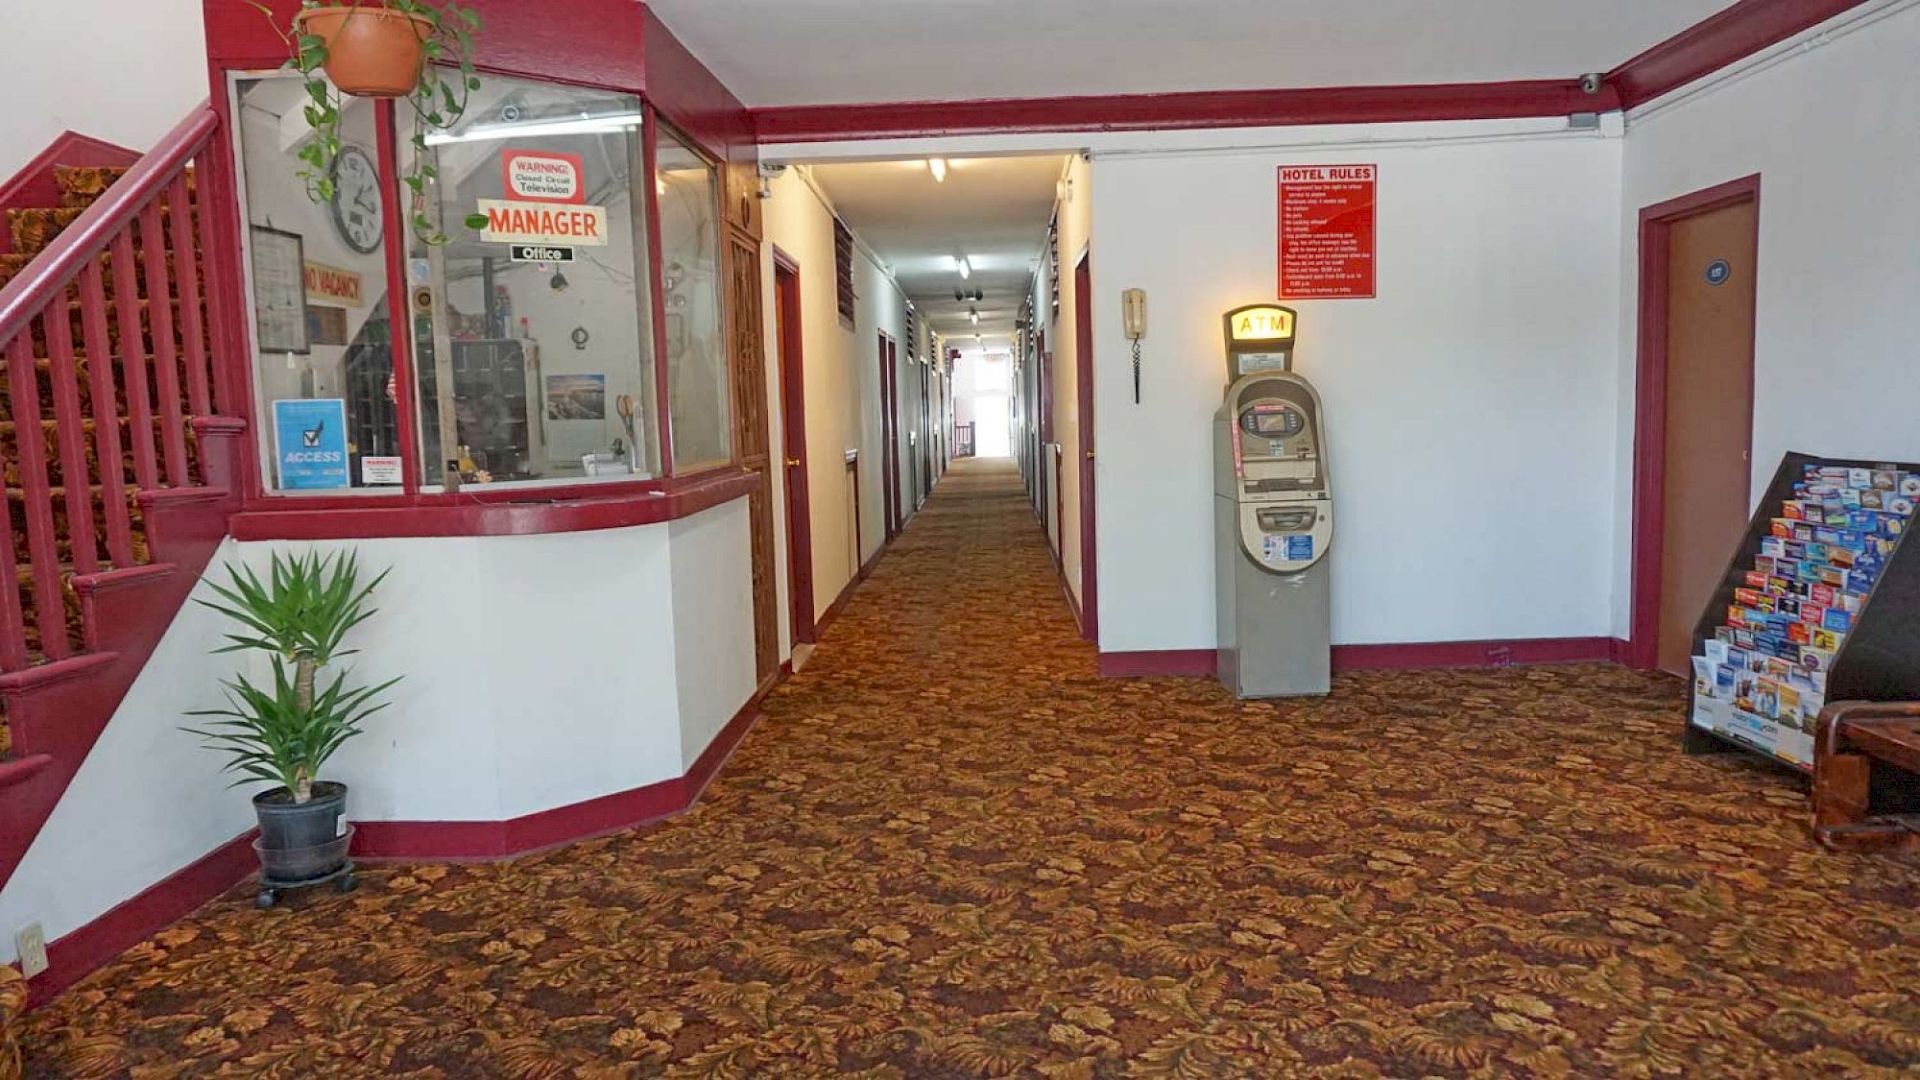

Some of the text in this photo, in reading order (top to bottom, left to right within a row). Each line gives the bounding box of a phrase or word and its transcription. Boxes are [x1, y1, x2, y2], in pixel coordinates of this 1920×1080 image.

[515, 173, 542, 183] Closed
[1282, 168, 1371, 180] HOTEL RULES
[520, 182, 569, 193] Television
[487, 207, 598, 237] MANAGER
[522, 247, 562, 260] Office
[318, 270, 359, 300] VACANCY
[1240, 315, 1285, 332] ATM
[285, 450, 341, 463] ACCESS
